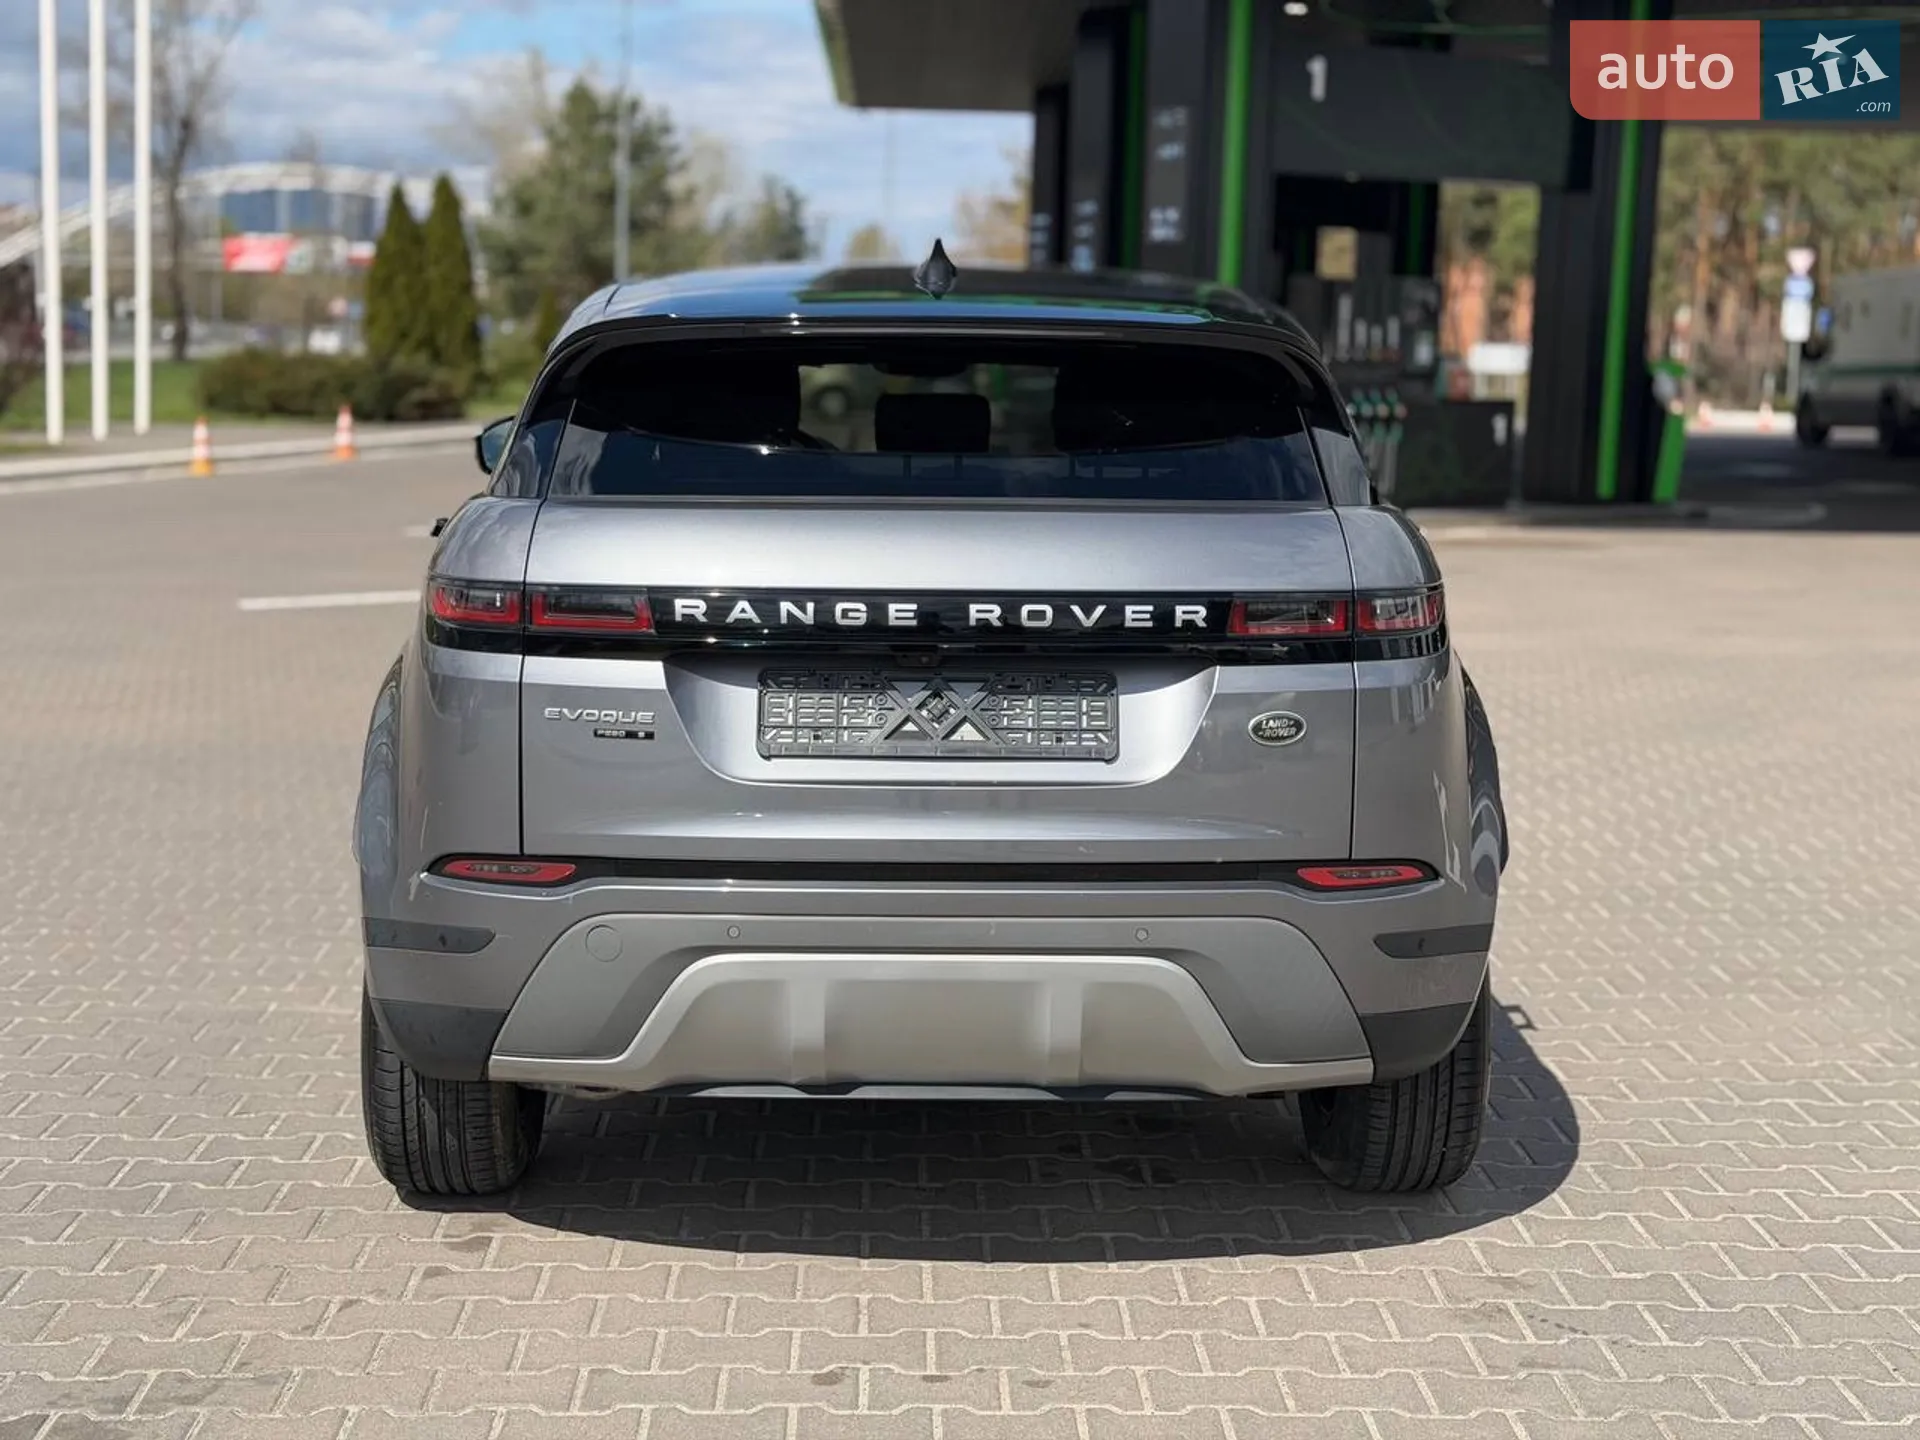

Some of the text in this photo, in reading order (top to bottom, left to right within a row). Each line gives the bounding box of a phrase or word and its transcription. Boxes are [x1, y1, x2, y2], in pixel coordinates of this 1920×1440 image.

[1305, 55, 1328, 102] 1
[674, 599, 1207, 628] RANGE ROVER
[544, 707, 655, 724] EVOQUE
